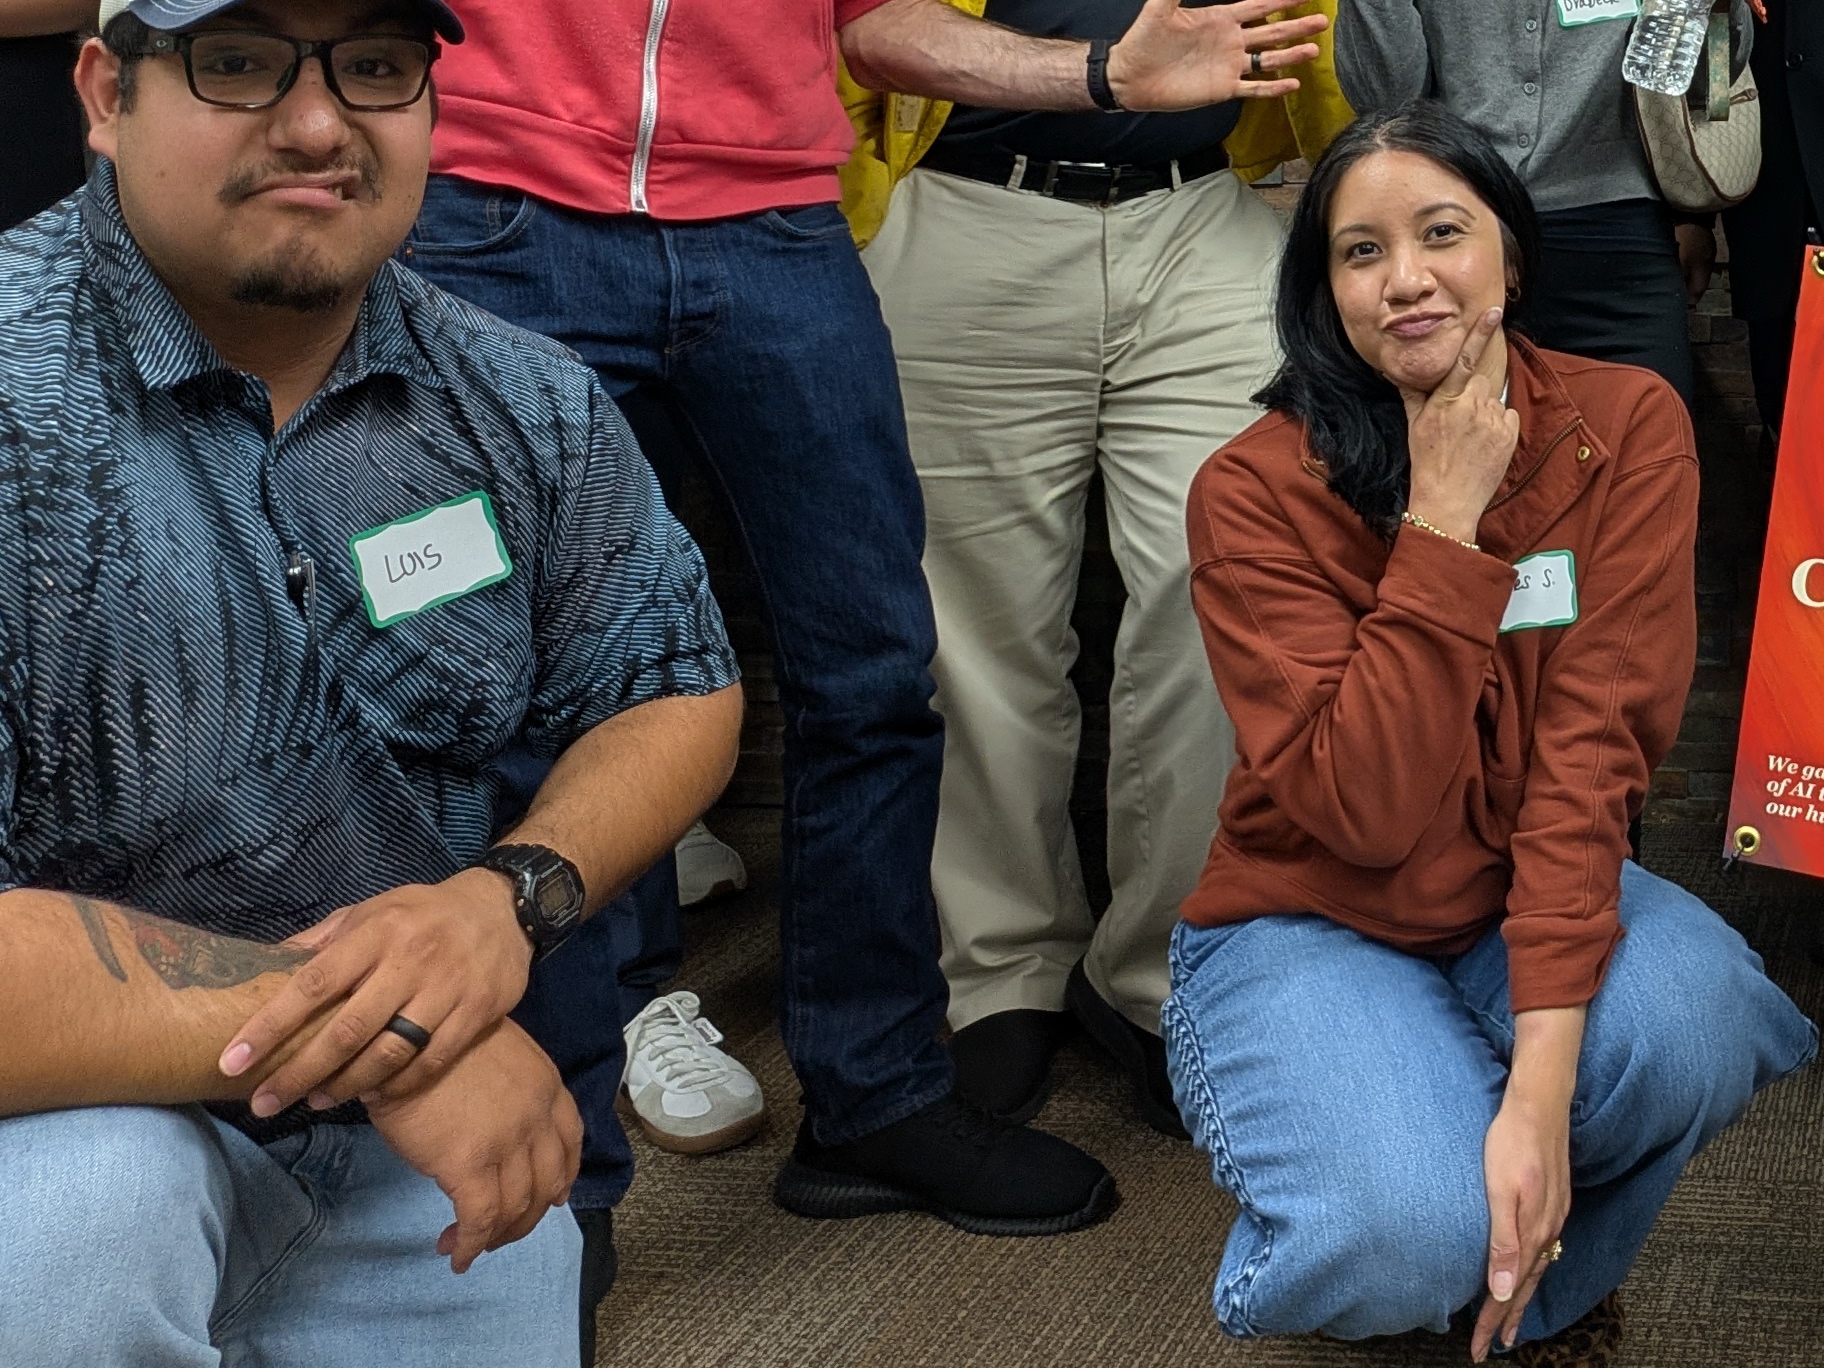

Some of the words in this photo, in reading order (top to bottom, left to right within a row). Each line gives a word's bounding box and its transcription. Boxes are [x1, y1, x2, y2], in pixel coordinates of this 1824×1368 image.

[384, 543, 443, 583] LUIS
[1513, 575, 1531, 592] es
[1767, 755, 1799, 775] We
[1766, 778, 1791, 797] of
[1788, 781, 1816, 799] AI
[1765, 801, 1803, 819] our
